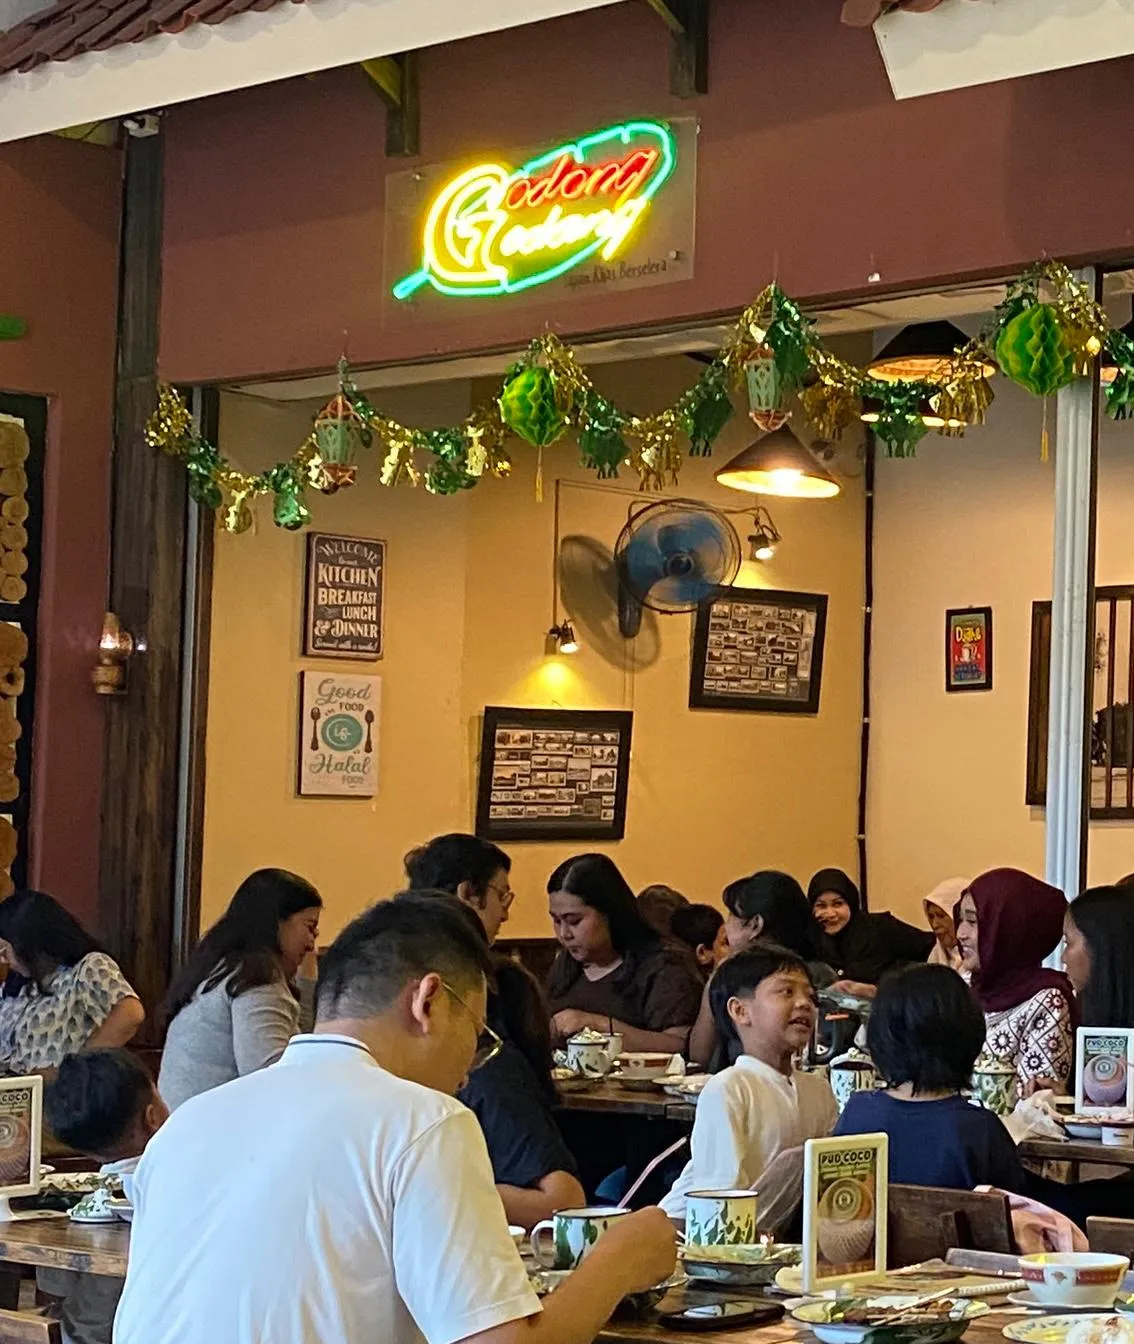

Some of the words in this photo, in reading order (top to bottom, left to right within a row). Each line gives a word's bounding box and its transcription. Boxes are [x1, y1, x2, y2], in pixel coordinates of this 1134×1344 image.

[317, 540, 380, 565] WELCOME
[318, 562, 381, 587] KITCHEN
[317, 588, 377, 606] BREAKFAST
[342, 605, 377, 621] LUNCH
[314, 619, 331, 637] &
[330, 618, 379, 638] DINNER
[315, 678, 372, 706] Good
[339, 702, 365, 712] FOOD
[309, 753, 372, 774] Halal
[2, 1092, 28, 1102] COCO
[821, 1152, 842, 1165] PUD
[843, 1150, 872, 1163] COCO
